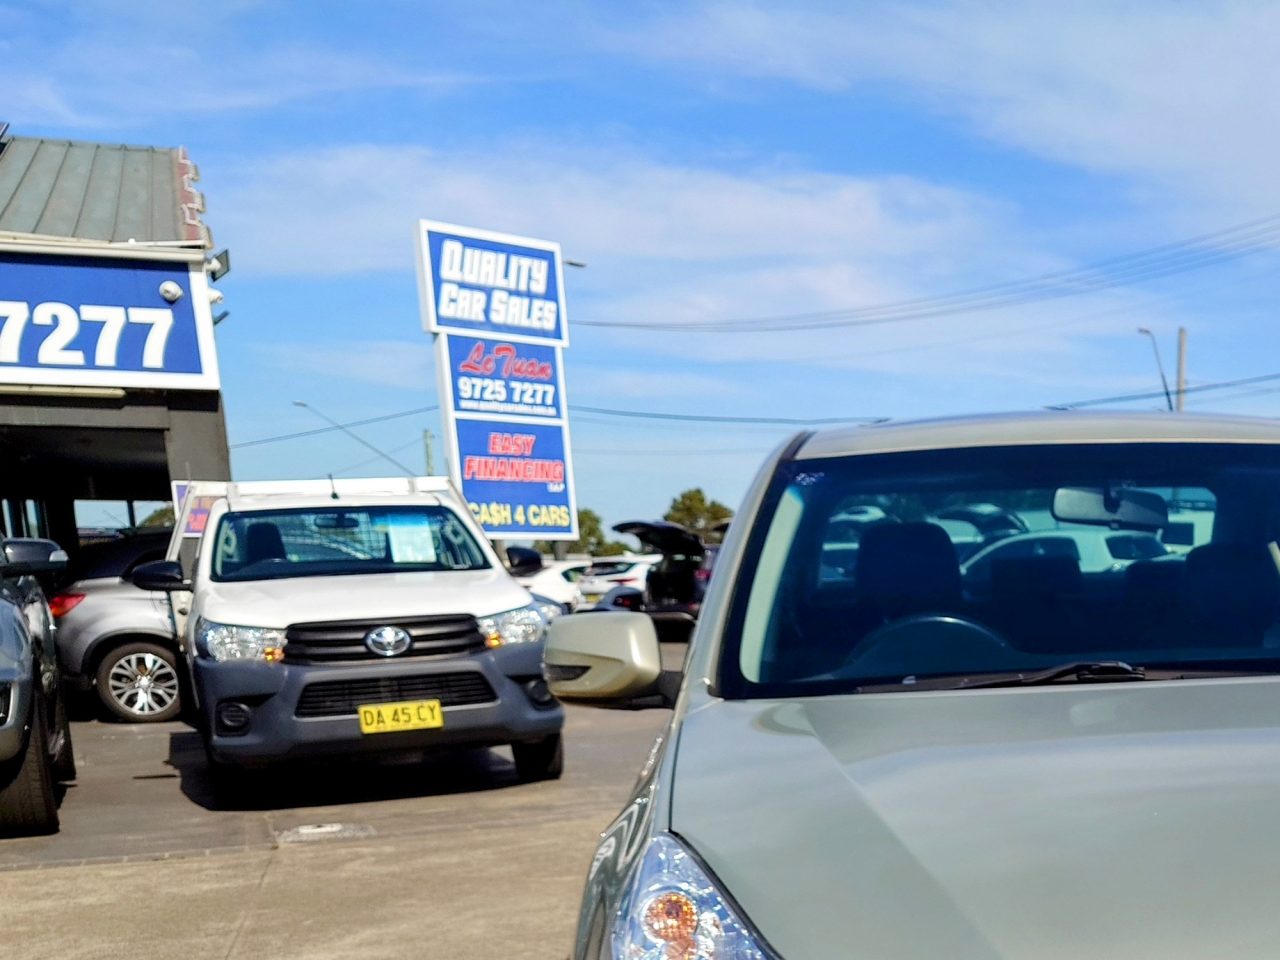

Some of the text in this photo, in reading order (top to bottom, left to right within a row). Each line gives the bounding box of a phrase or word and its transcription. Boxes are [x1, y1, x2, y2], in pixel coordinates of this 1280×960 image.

[440, 239, 549, 294] QUALITY
[438, 282, 557, 331] CAR SALES
[0, 301, 174, 368] 7277
[493, 343, 553, 380] Tuan
[458, 376, 555, 405] 9725 7277
[488, 432, 536, 456] EASY
[464, 455, 564, 483] FINANCING
[514, 504, 526, 525] 4
[527, 504, 570, 527] CARS
[363, 705, 436, 726] DA 45 CY
